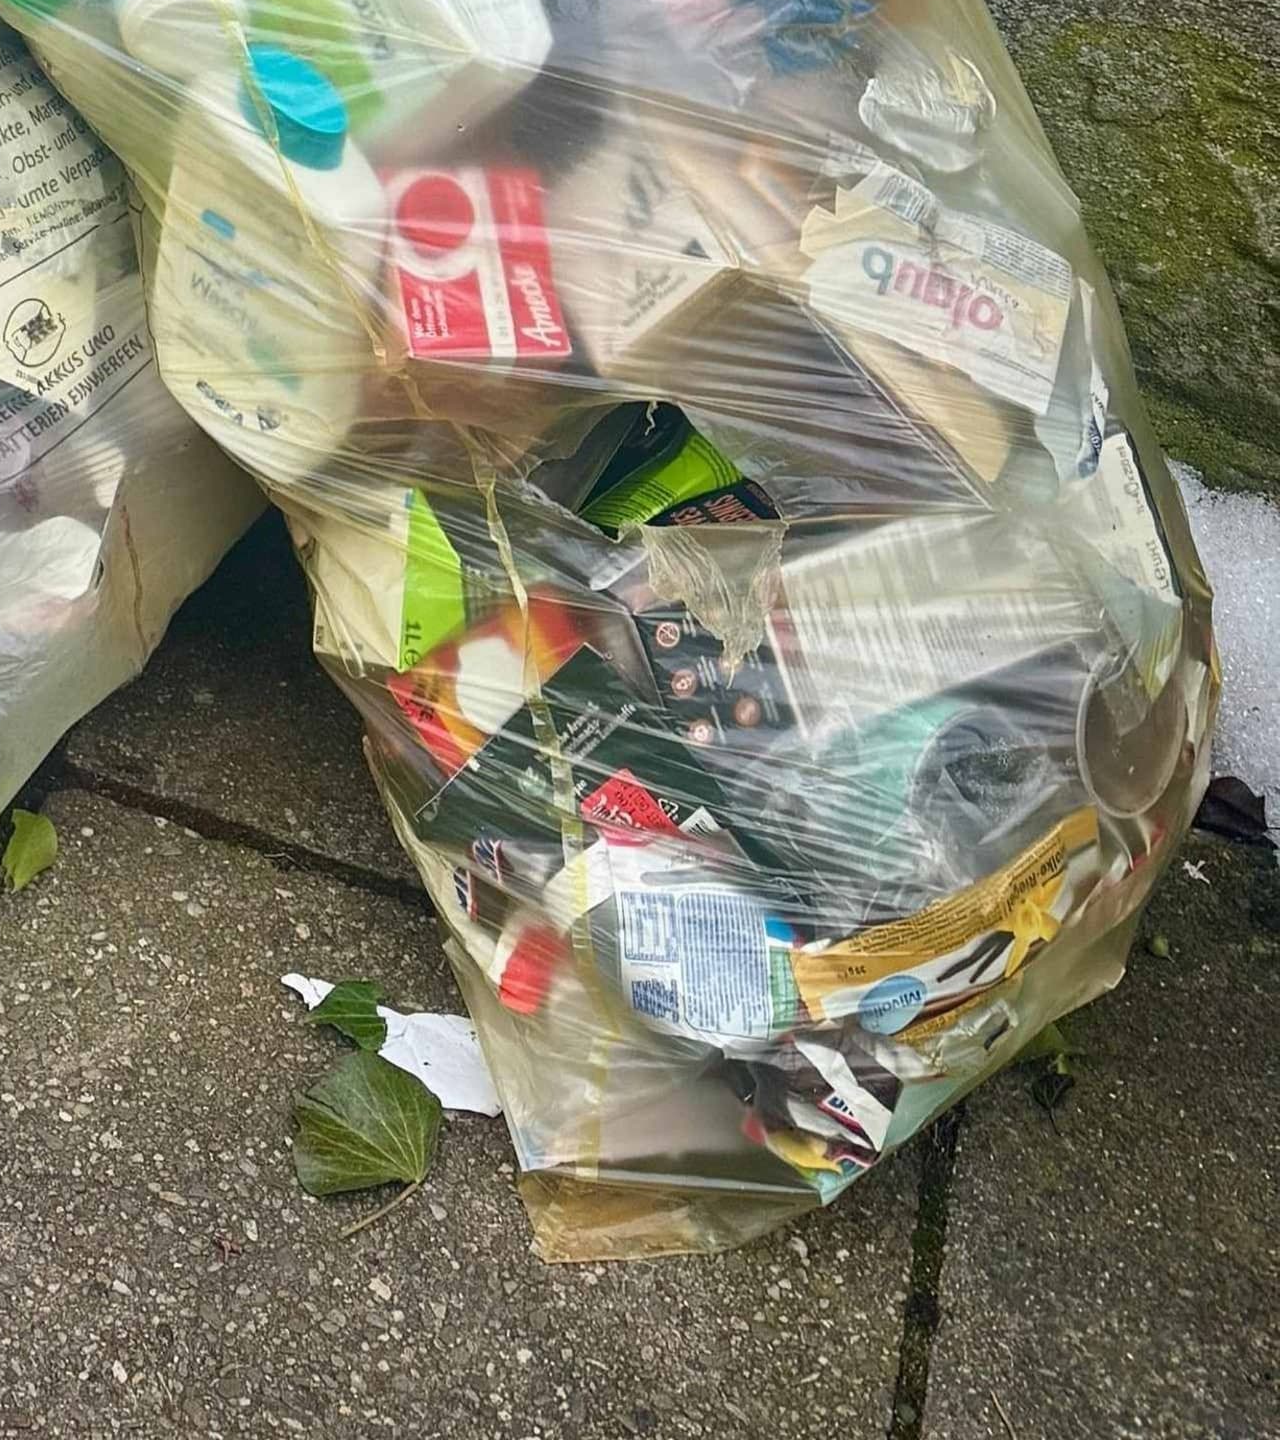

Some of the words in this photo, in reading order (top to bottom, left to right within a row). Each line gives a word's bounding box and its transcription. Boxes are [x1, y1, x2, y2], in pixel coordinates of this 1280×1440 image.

[11, 143, 53, 175] Obst-
[53, 127, 77, 152] und
[36, 349, 86, 398] AKKUS
[84, 323, 117, 359] UND
[68, 332, 145, 407] EINWERFEN
